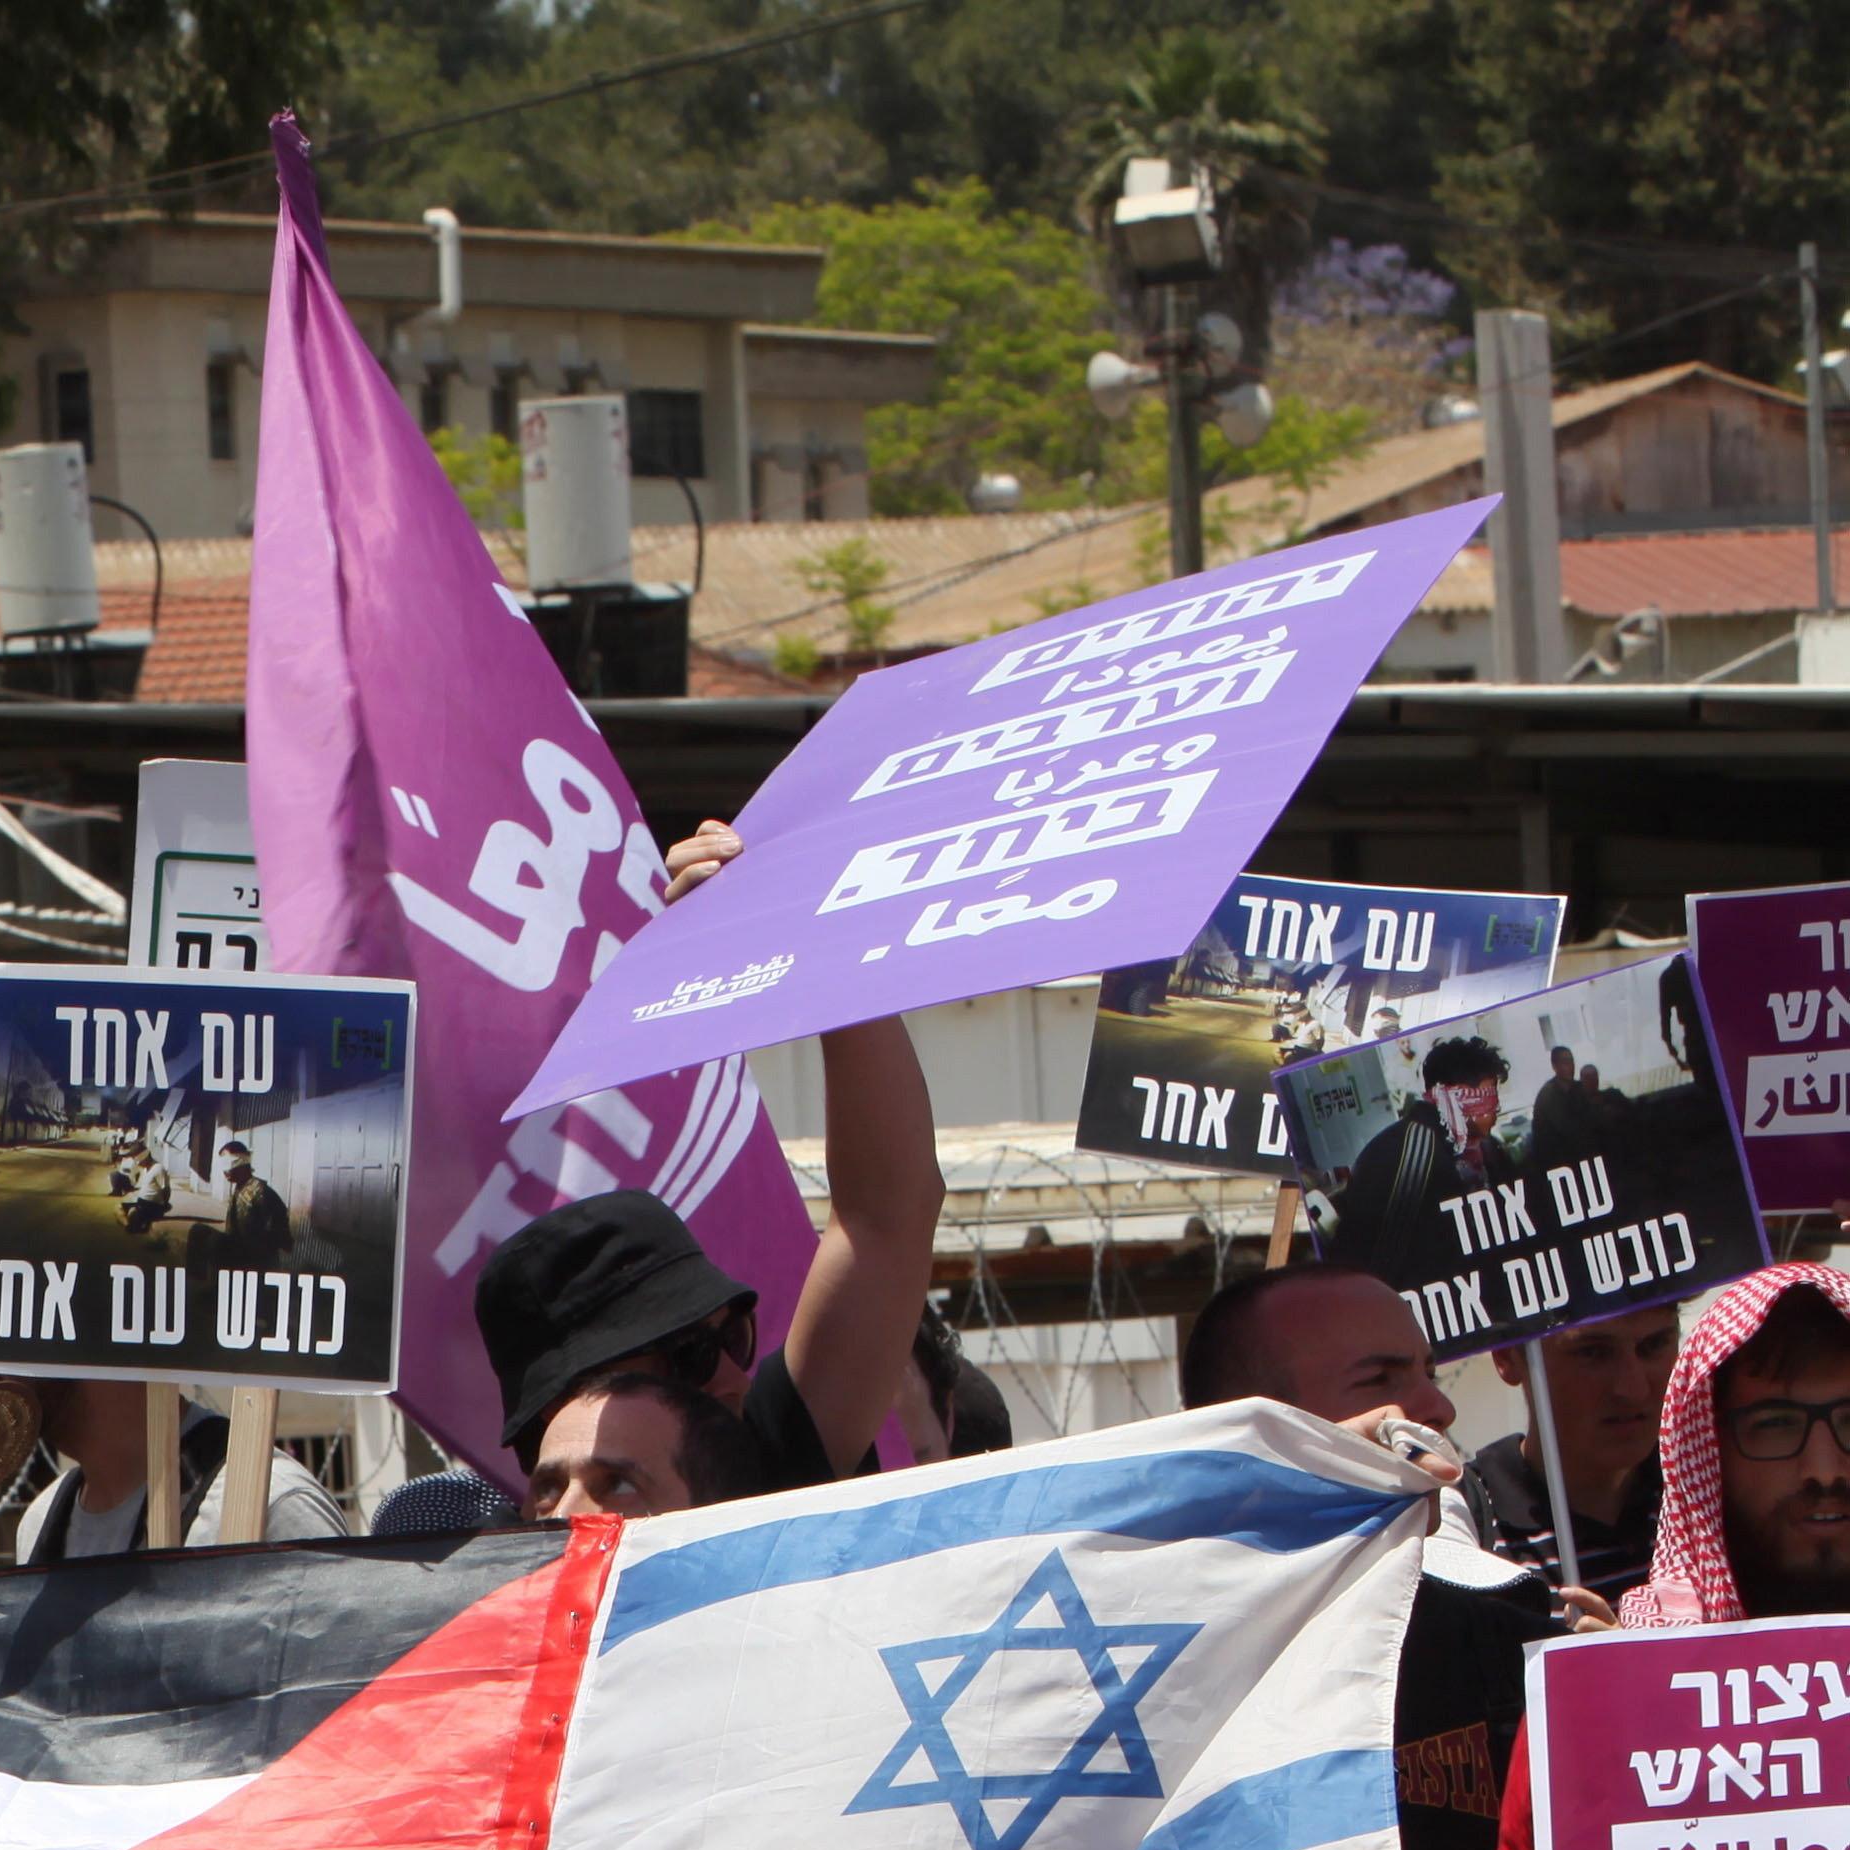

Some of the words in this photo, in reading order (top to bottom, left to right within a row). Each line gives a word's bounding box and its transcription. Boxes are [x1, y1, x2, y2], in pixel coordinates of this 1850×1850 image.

[1019, 566, 1338, 664] יהודים
[883, 667, 1254, 786] וערבים
[1239, 895, 1340, 965] אחד
[1363, 910, 1435, 973] עם
[55, 1006, 169, 1089] אחד
[201, 1011, 274, 1093] עם
[1132, 1076, 1234, 1150] אחר
[1439, 1179, 1536, 1255] אחד
[1547, 1156, 1614, 1226] עם
[1502, 1248, 1569, 1318] עם
[1582, 1213, 1695, 1294] כובש
[110, 1263, 186, 1345] עם
[216, 1269, 346, 1355] כובש
[1629, 1737, 1821, 1808] האש
